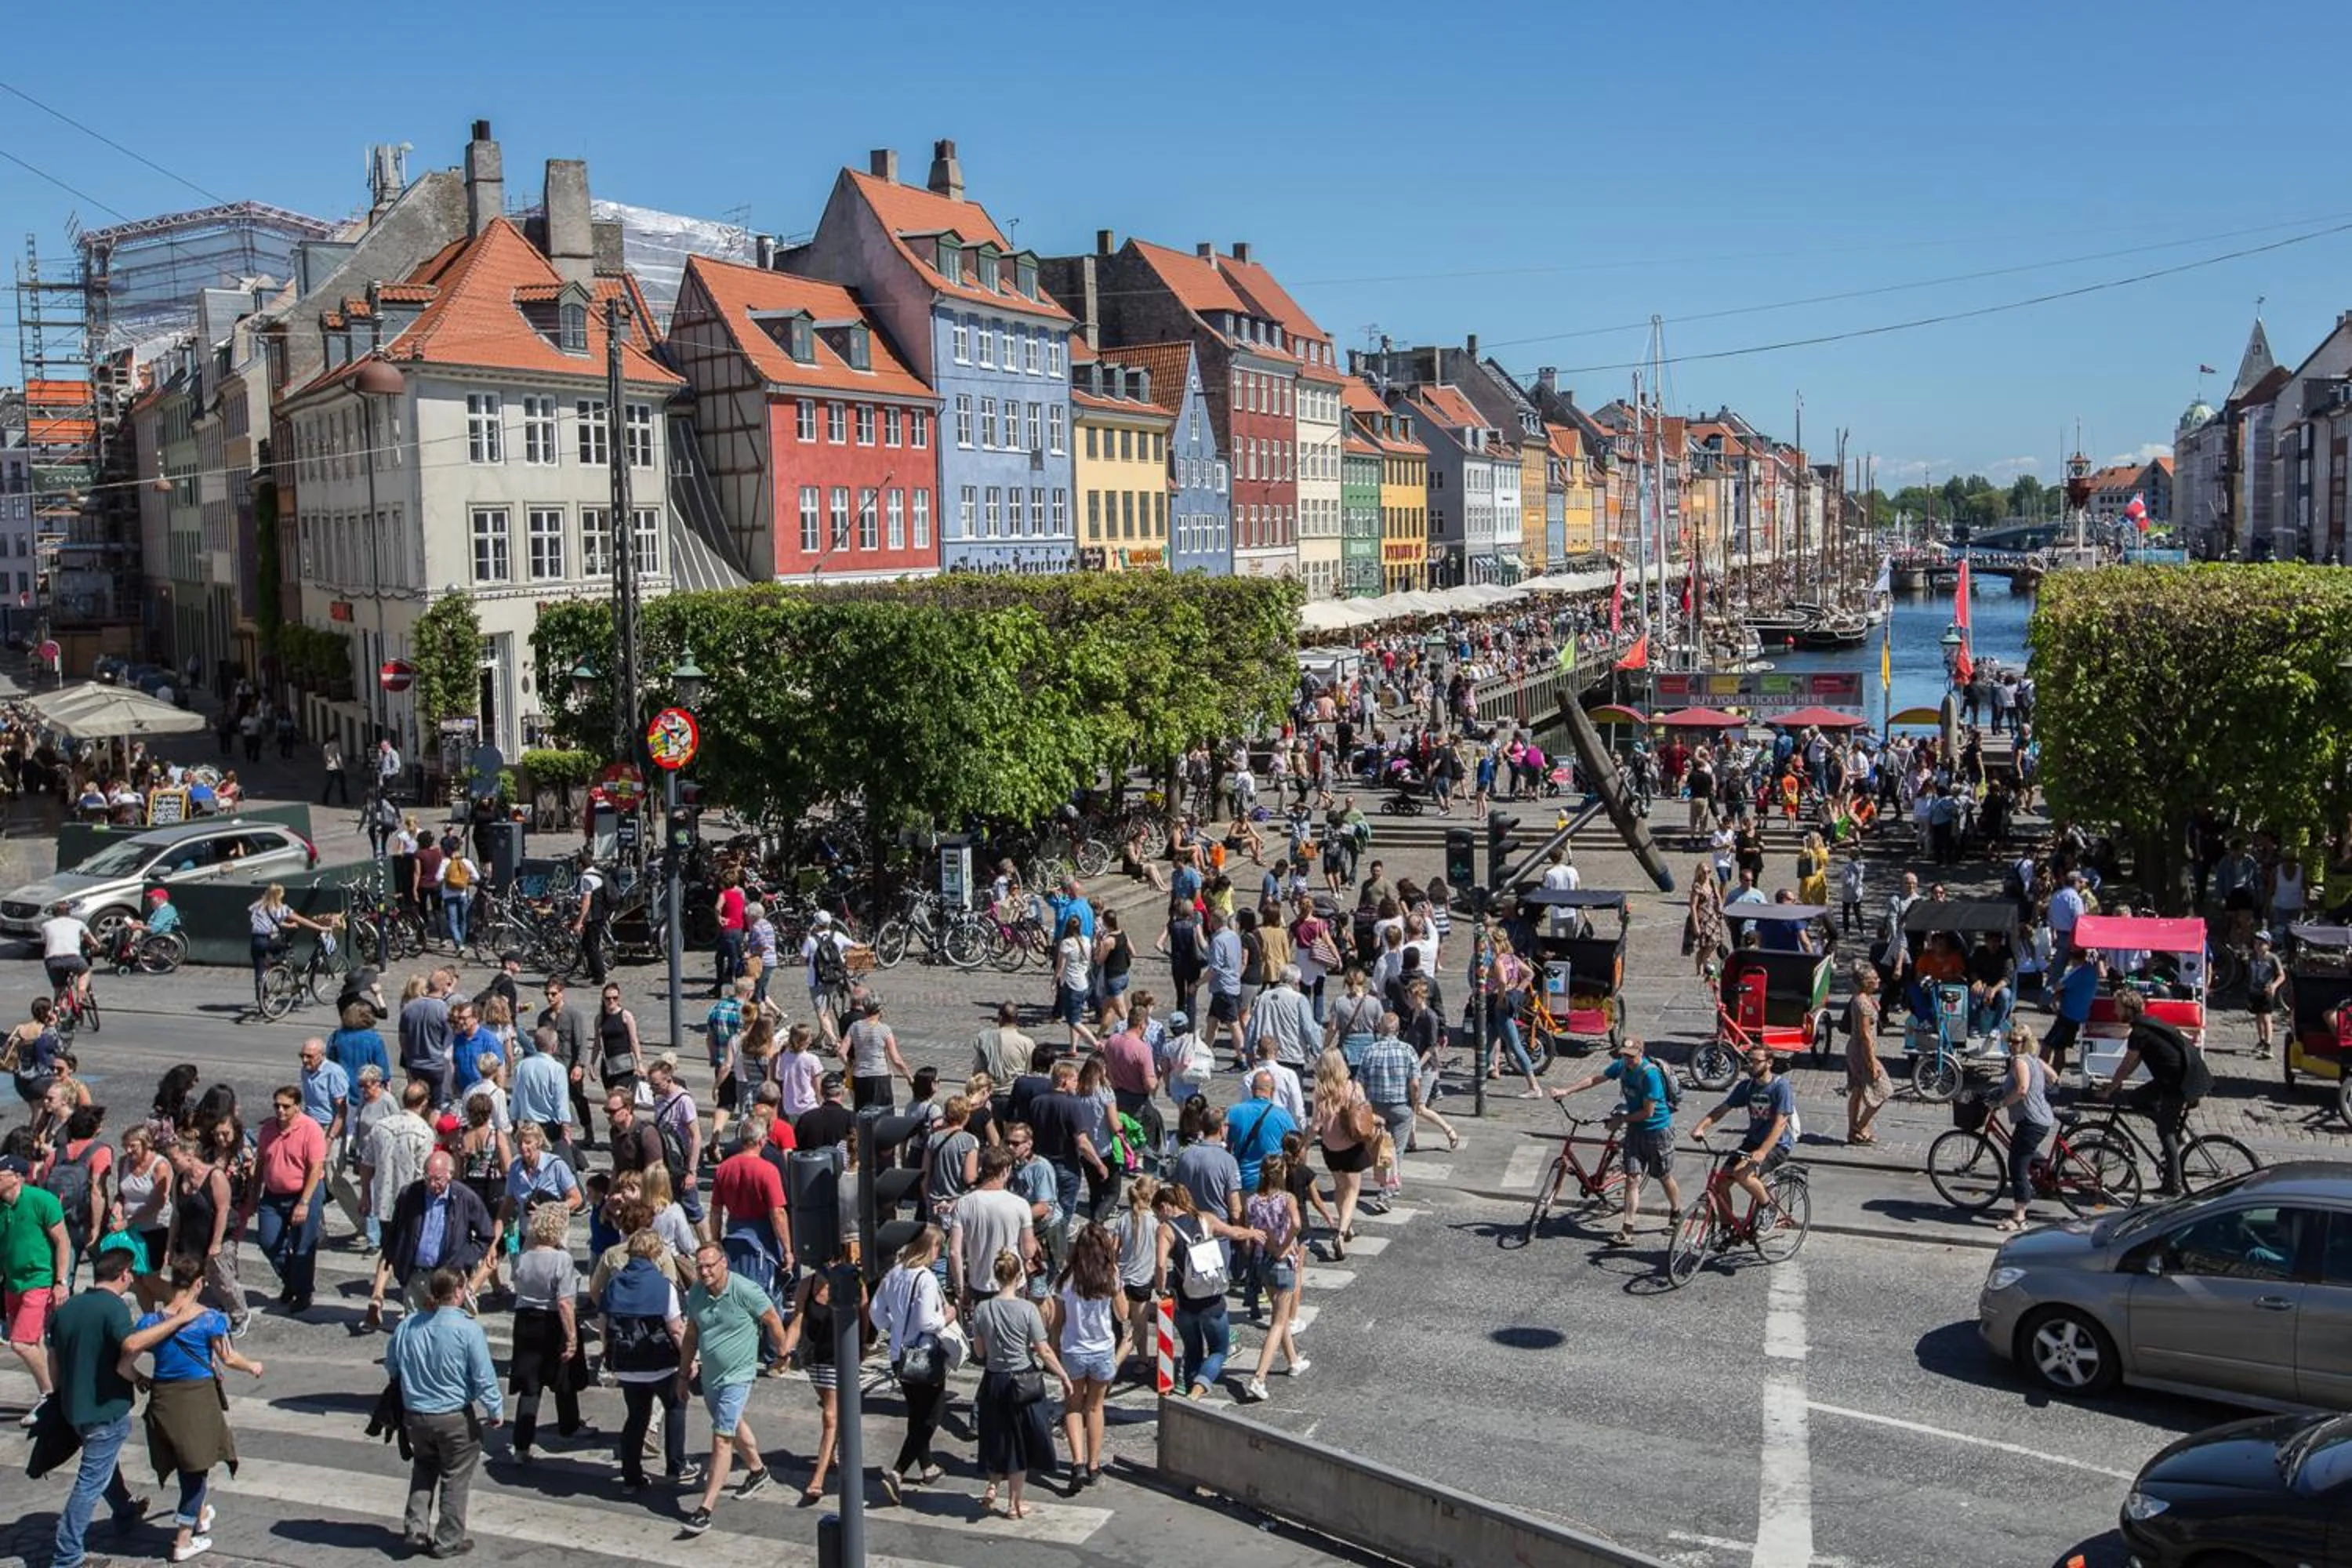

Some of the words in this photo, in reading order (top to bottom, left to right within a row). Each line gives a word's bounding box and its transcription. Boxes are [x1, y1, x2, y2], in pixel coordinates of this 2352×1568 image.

[1689, 694, 1713, 705] BUY
[1715, 694, 1747, 705] YOUR
[1750, 694, 1794, 705] TICKETS
[1796, 694, 1825, 705] HERE
